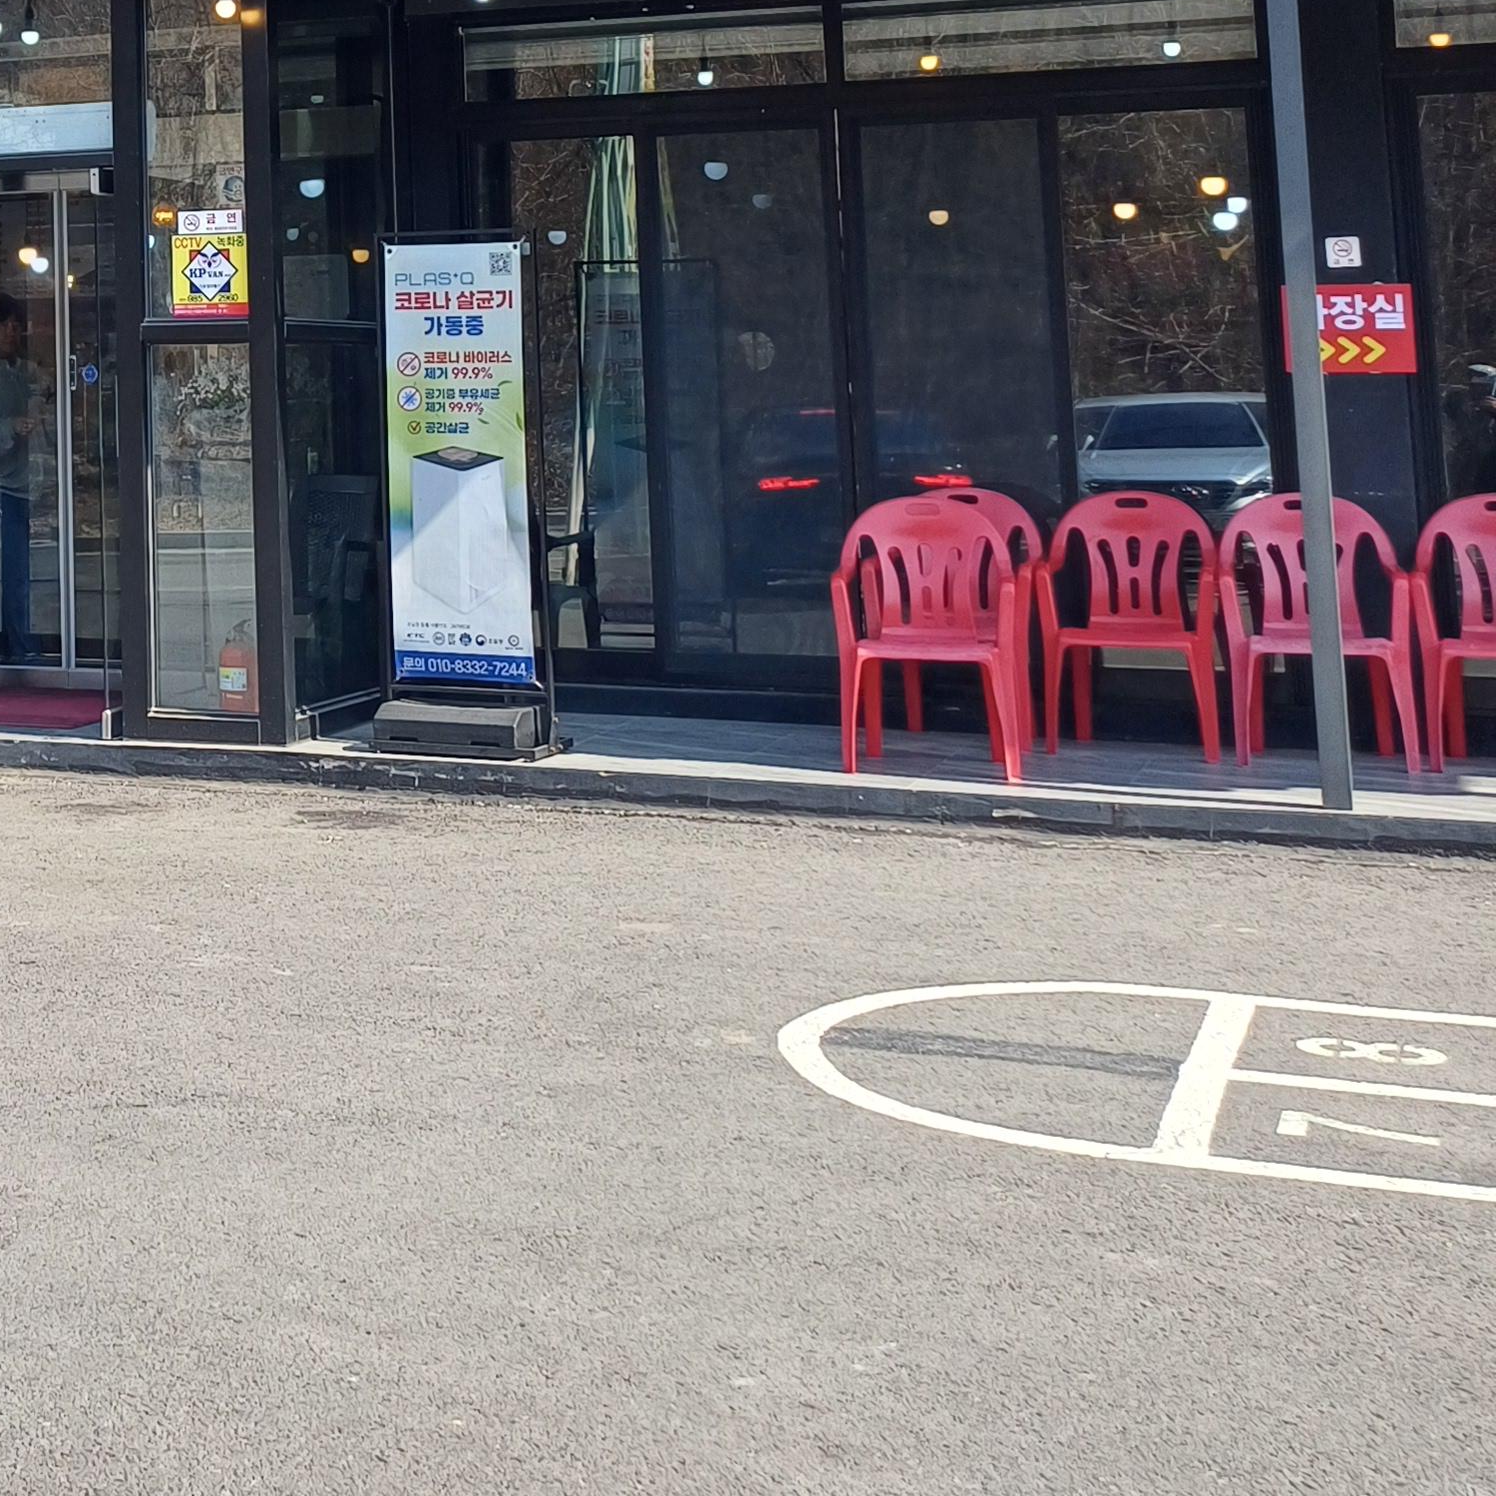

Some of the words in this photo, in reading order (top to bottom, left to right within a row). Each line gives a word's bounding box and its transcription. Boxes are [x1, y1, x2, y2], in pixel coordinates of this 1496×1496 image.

[174, 237, 202, 249] CCTV
[217, 236, 244, 247] 녹화중
[395, 291, 451, 310] 코로나
[456, 290, 513, 310] 살균기
[424, 315, 484, 336] 가동중
[424, 351, 460, 364] 코로나
[464, 350, 513, 364] 바이러스
[451, 366, 493, 380] 99.9%
[448, 401, 484, 415] 99.9%
[403, 657, 424, 671] 문의
[428, 658, 527, 677] 010-8332-7244
